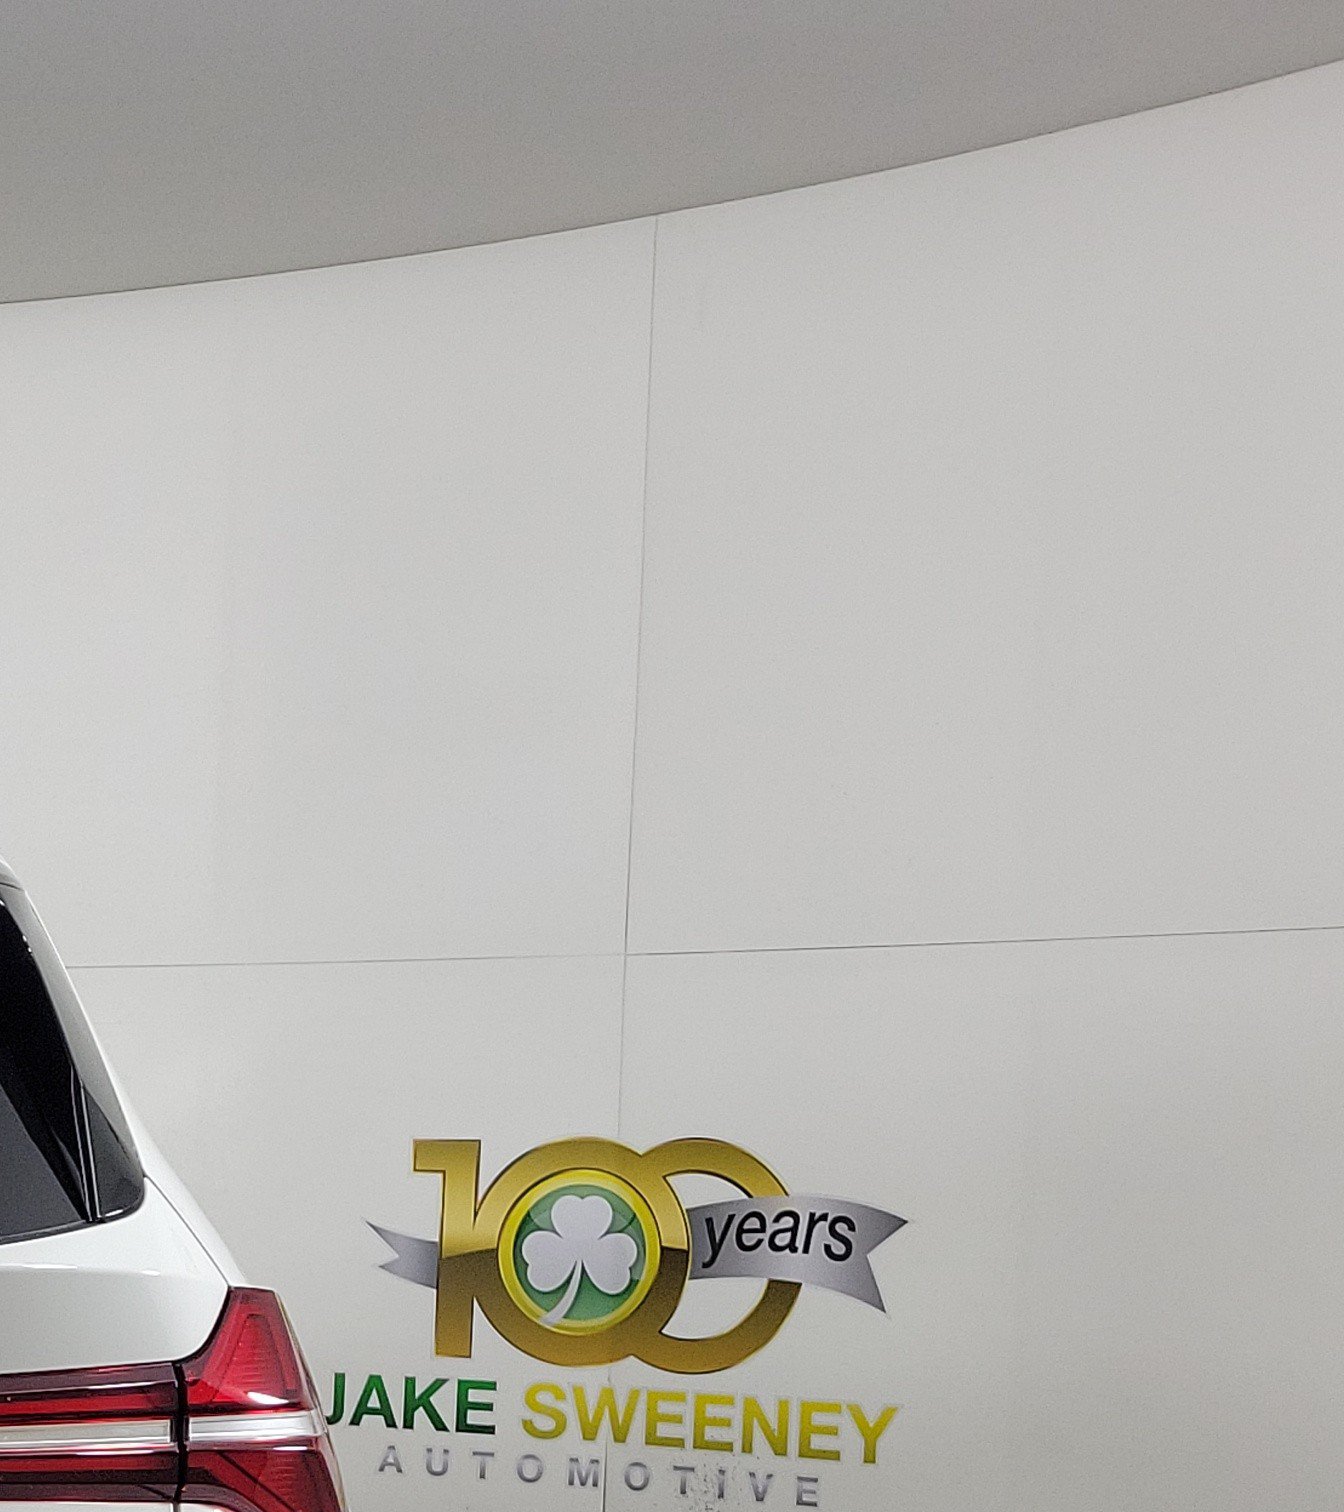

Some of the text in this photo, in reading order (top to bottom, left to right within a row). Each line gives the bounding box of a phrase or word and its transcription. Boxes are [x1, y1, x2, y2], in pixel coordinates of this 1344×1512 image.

[413, 1136, 857, 1375] 100 years
[325, 1372, 900, 1465] JAKE SWEENEY
[377, 1445, 820, 1508] AUTOMOTIVE
